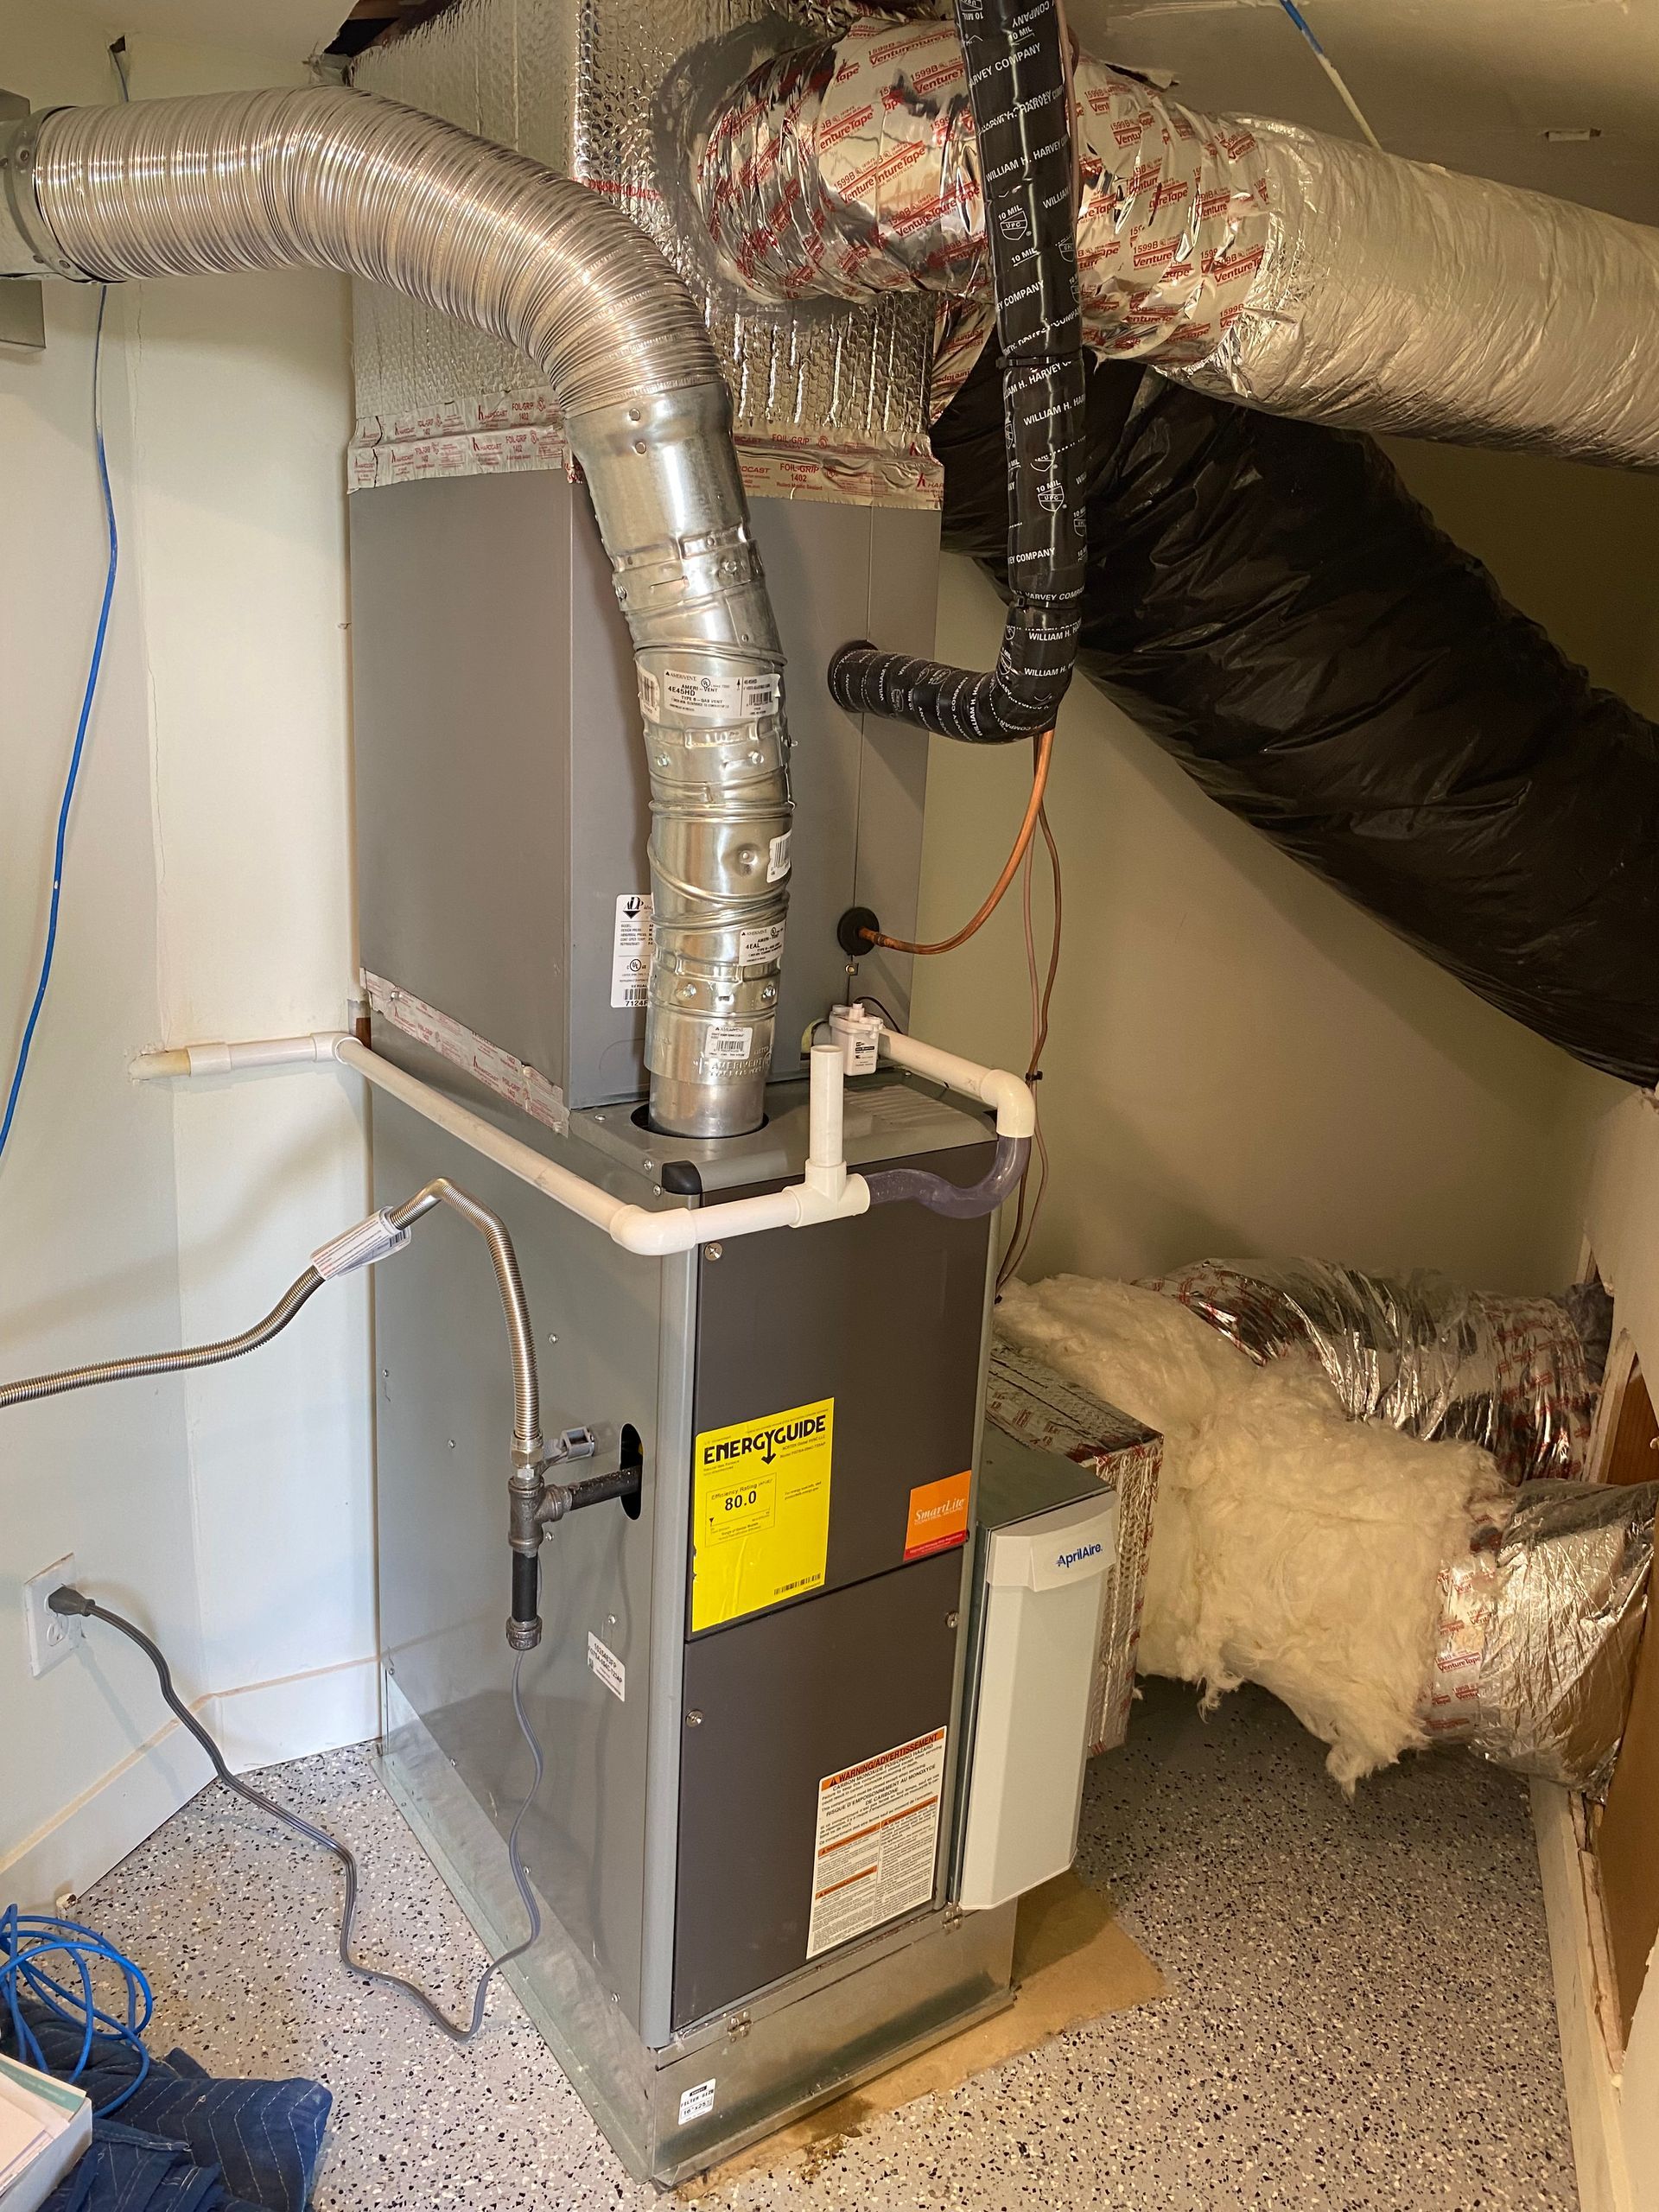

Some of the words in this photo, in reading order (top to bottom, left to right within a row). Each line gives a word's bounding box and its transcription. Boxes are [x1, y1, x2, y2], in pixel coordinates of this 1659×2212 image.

[1012, 0, 1050, 28] COMPANY
[1019, 26, 1033, 36] MIL
[969, 66, 992, 86] ARVEY
[995, 42, 1041, 71] COMPANY
[911, 65, 938, 81] 1599B
[913, 69, 965, 94] VentureT
[820, 111, 874, 149] entureTape
[931, 117, 950, 130] 1599
[1229, 139, 1255, 160] Venture
[877, 147, 926, 183] ntureTape
[985, 159, 1020, 182] WILLIAM
[1033, 141, 1061, 161] HARVEY
[834, 171, 855, 190] 1599B
[998, 213, 1007, 221] 10
[1007, 204, 1023, 216] MIL
[1083, 199, 1116, 218] reTape
[1198, 204, 1227, 218] Venture
[1011, 254, 1020, 264] 10
[1021, 247, 1038, 258] MIL
[1134, 242, 1158, 253] 1599B
[1201, 248, 1217, 259] 1599
[1134, 249, 1175, 267] VentureT
[1004, 280, 1044, 307] COMPANY
[1220, 303, 1244, 317] 1599B
[1028, 363, 1061, 384] HARVEY
[1023, 405, 1061, 426] WILLIAM
[1063, 402, 1071, 411] H.
[772, 434, 810, 445] FOIL-GRIP
[780, 463, 819, 474] FOIL-GRIP
[791, 474, 807, 482] 1402
[1046, 480, 1061, 489] MIL
[1016, 547, 1055, 563] COMPANY
[1028, 632, 1063, 641] WILLIAM
[671, 672, 696, 681] AMERIVENT
[1024, 667, 1058, 677] WILLIAM
[667, 685, 695, 696] 4E45HD
[969, 706, 982, 735] WILLIAM
[703, 1414, 826, 1465] ENERGYGUIDE
[740, 1483, 757, 1491] Rating
[725, 1489, 756, 1511] 80.0
[1057, 1542, 1102, 1568] AprilAire
[1439, 1656, 1481, 1672] VentureTape
